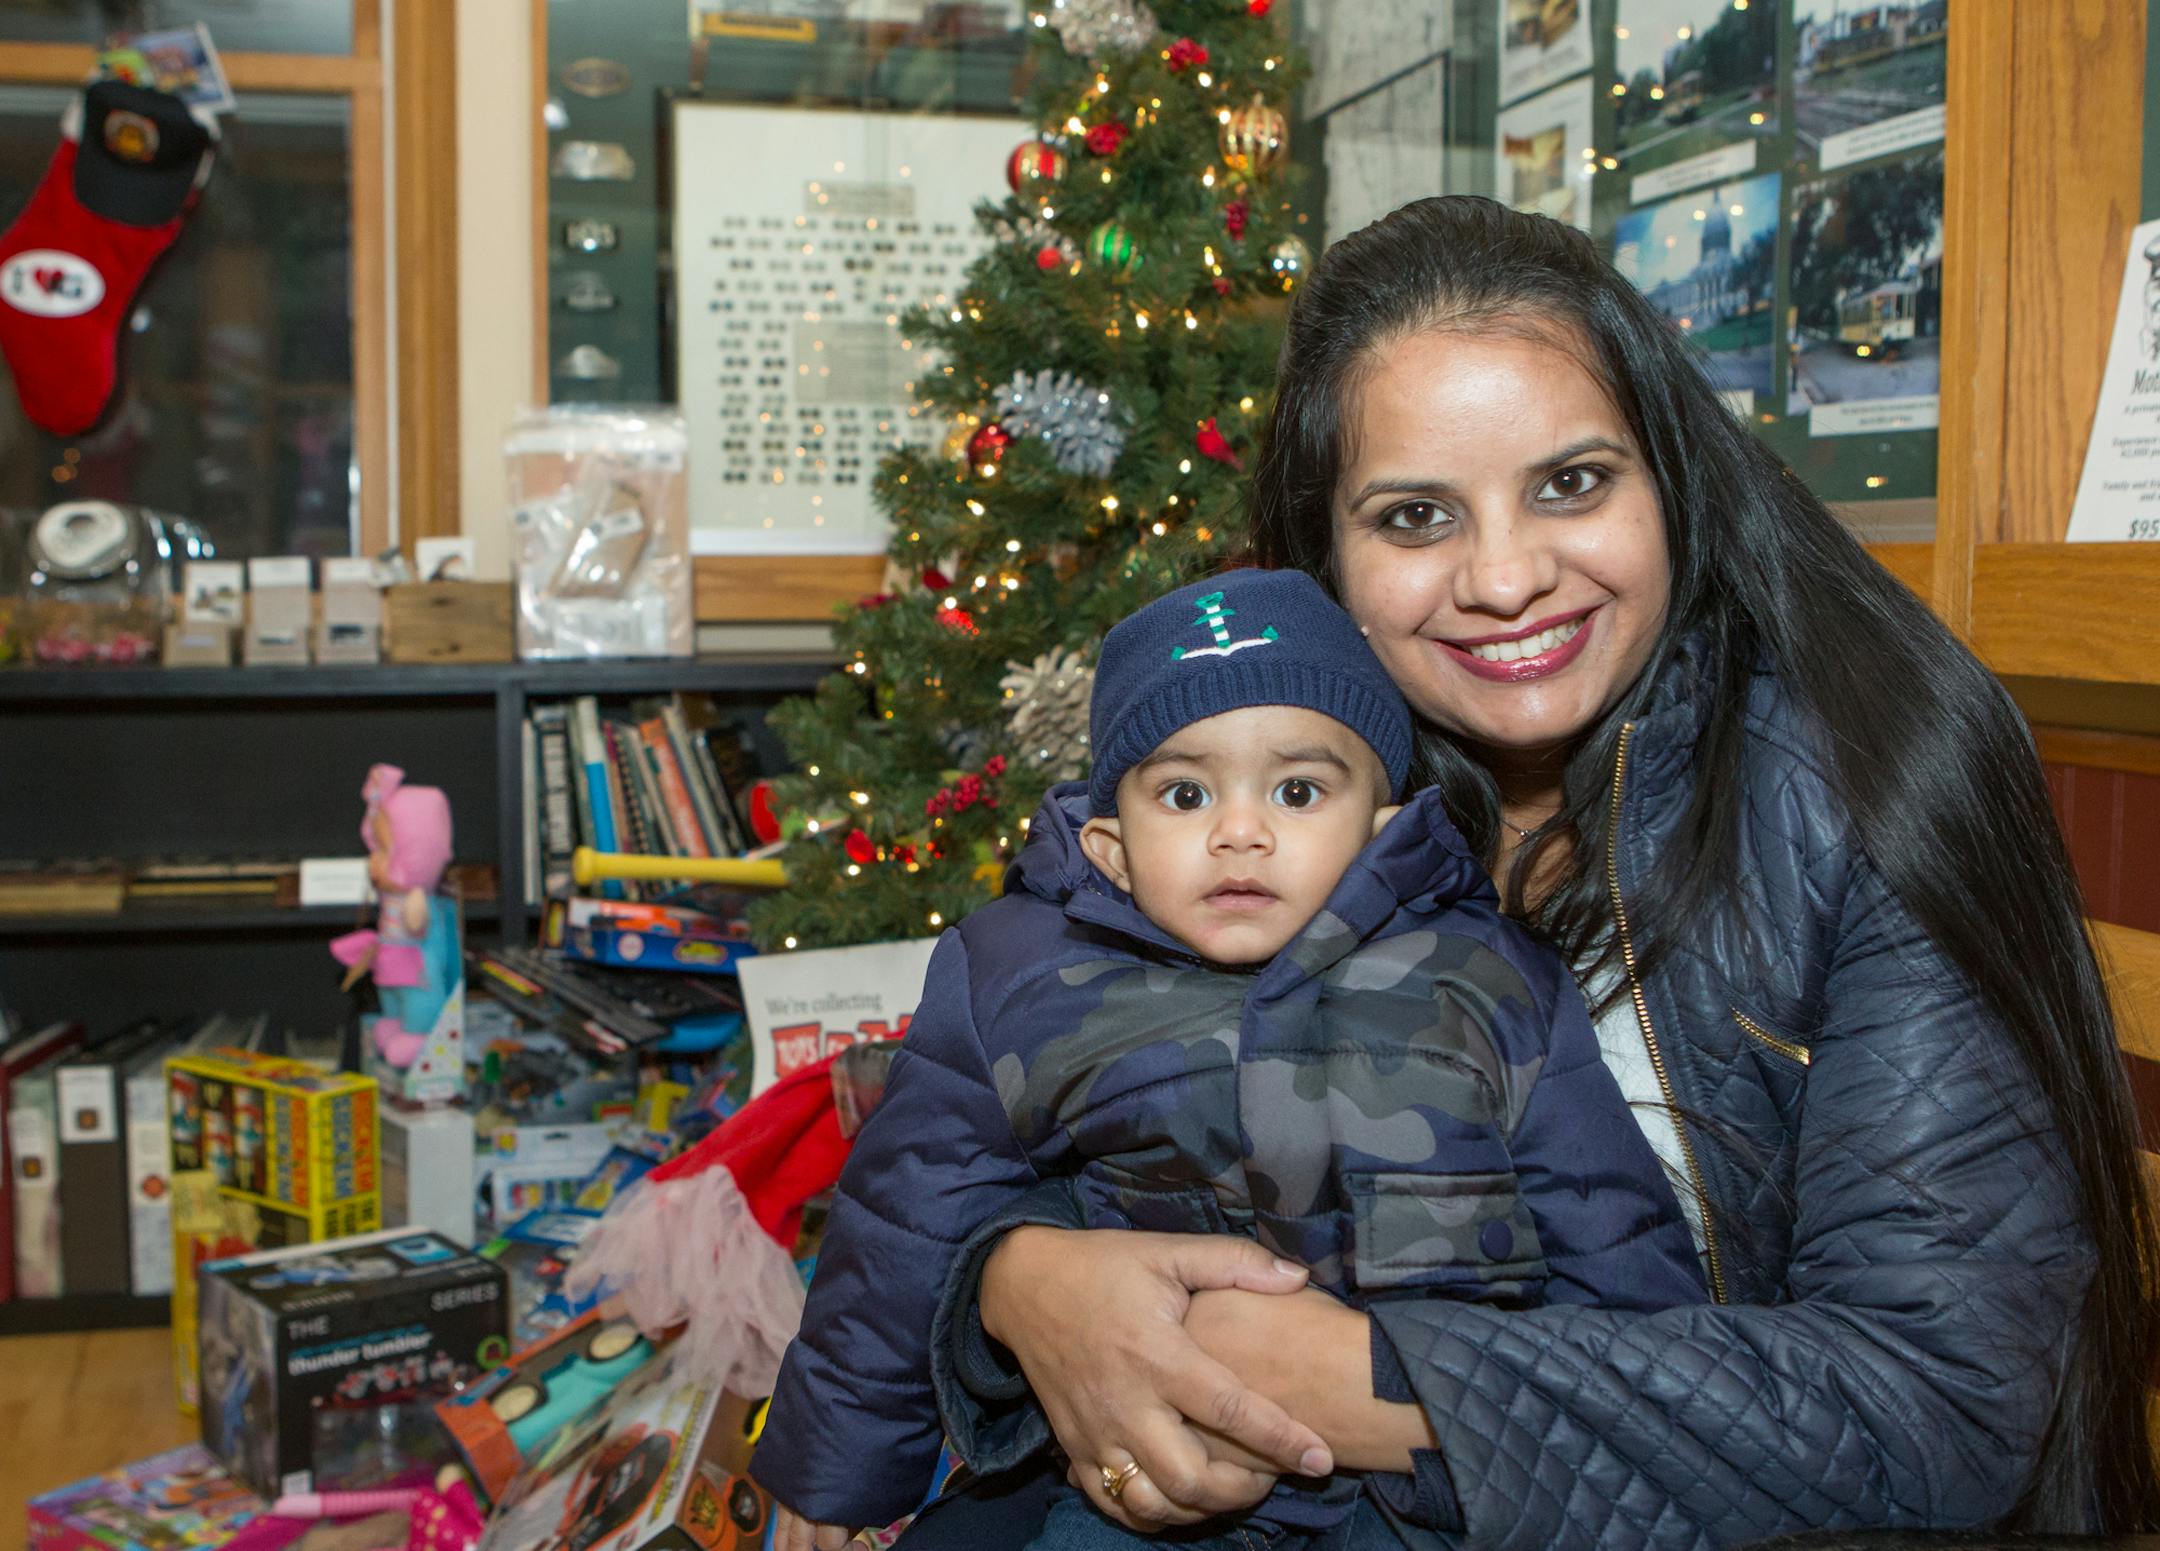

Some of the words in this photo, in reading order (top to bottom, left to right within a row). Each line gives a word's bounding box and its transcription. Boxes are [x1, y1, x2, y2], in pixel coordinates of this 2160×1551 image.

[812, 992, 883, 1014] collecting
[430, 1282, 500, 1312] SERIES
[287, 1314, 330, 1340] THE
[287, 1348, 360, 1377] thunder
[361, 1331, 434, 1361] tumbler
